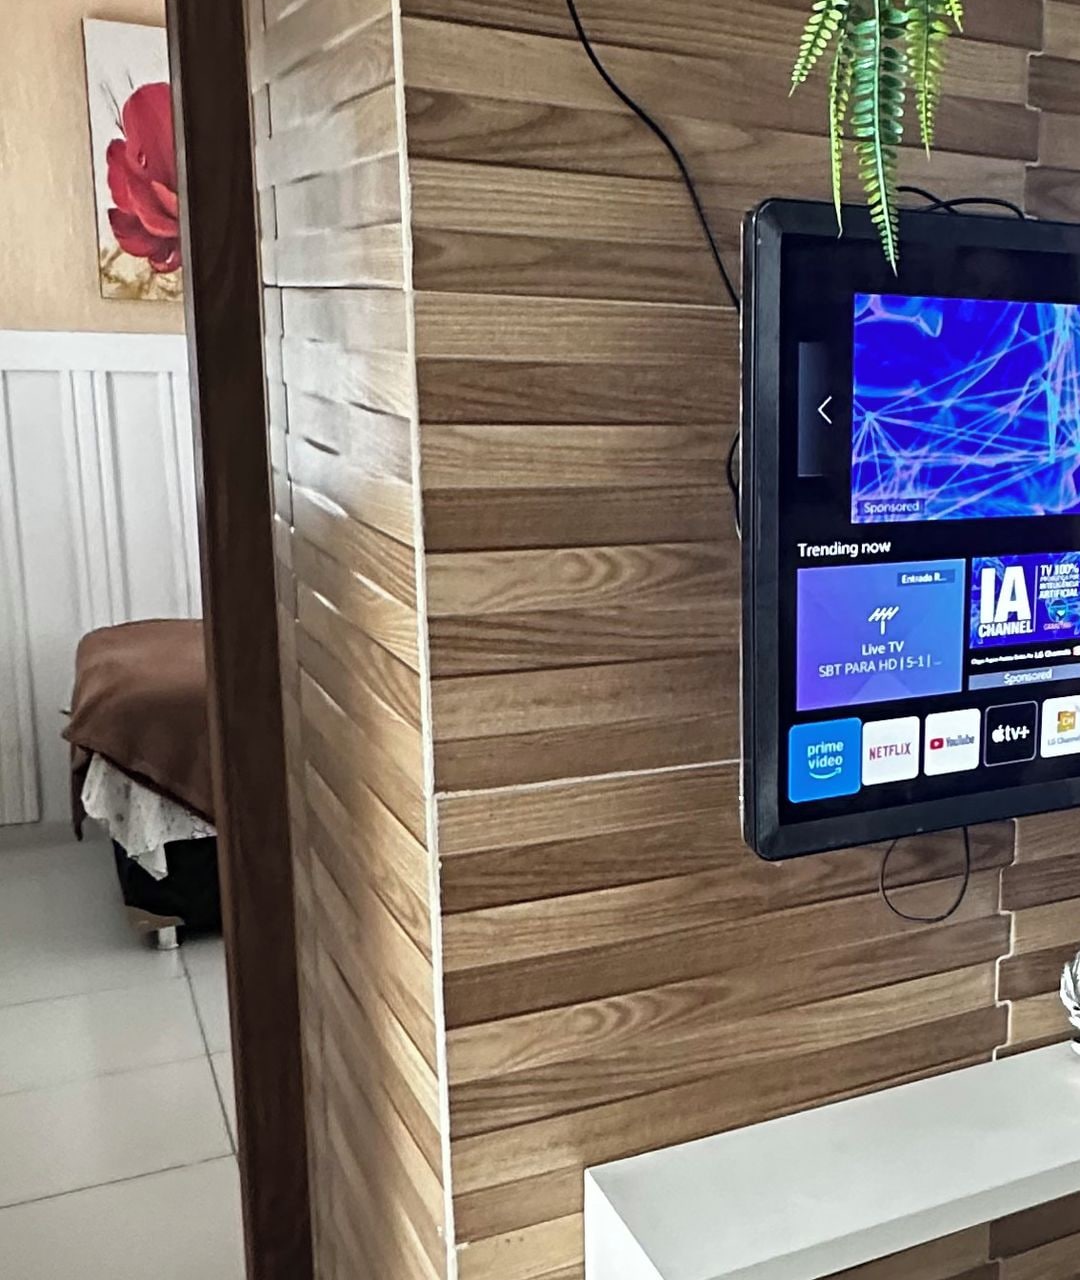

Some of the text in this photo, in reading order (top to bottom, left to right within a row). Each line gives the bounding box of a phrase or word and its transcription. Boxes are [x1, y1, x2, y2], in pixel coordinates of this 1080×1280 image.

[863, 500, 920, 515] Sponsored
[797, 541, 892, 558] Trending now
[1040, 563, 1080, 576] TV 100%
[980, 566, 1032, 624] IA
[978, 621, 1033, 637] CHANNEL
[861, 640, 905, 656] Live TV
[818, 663, 842, 678] SBT
[844, 660, 876, 675] PARA
[879, 657, 898, 671] HD
[1004, 669, 1053, 685] Sponsored
[807, 740, 844, 757] prime
[946, 734, 975, 748] YouTube
[869, 742, 912, 761] NETFLIX
[807, 755, 843, 770] video
